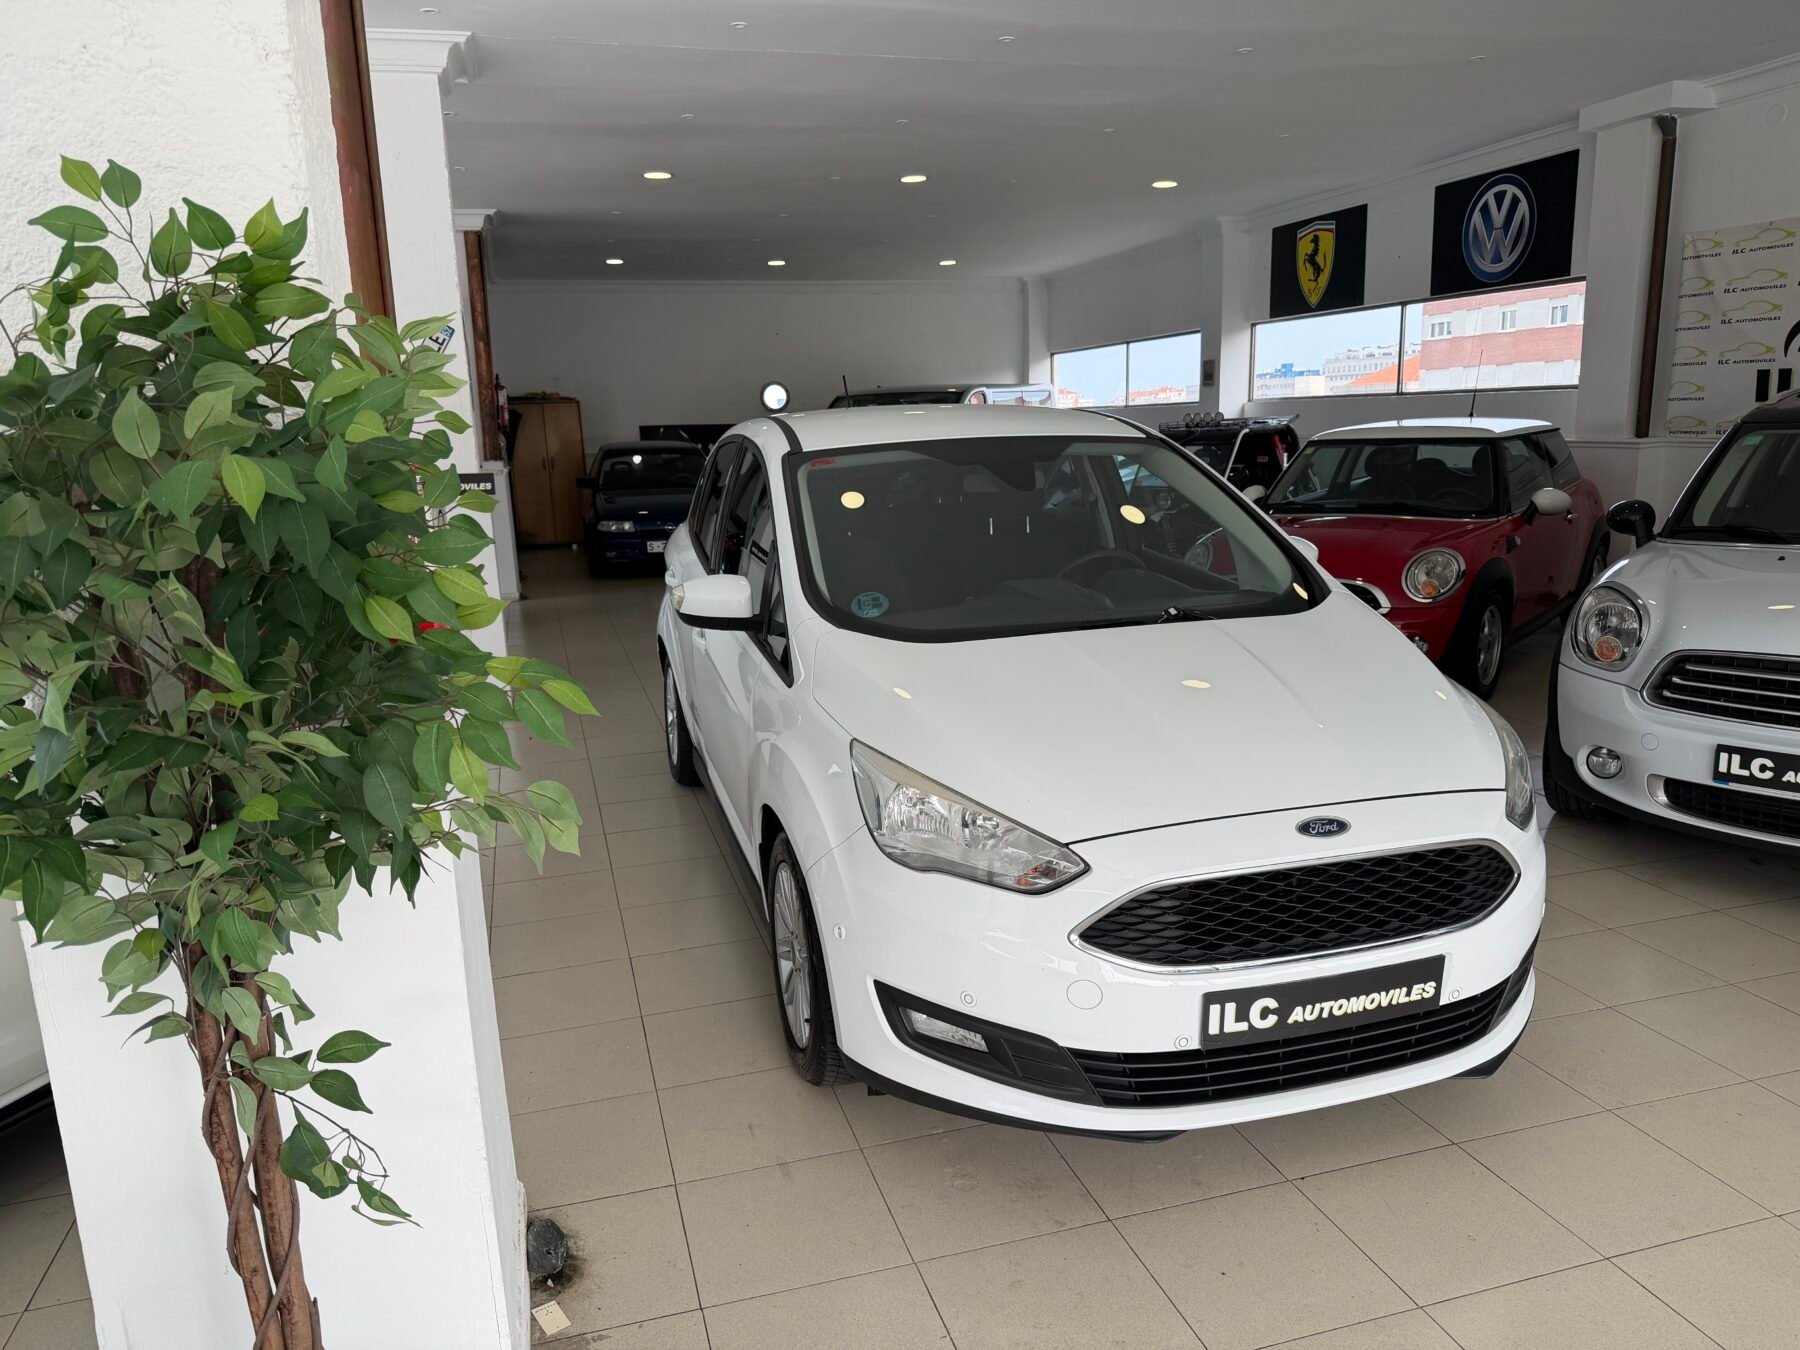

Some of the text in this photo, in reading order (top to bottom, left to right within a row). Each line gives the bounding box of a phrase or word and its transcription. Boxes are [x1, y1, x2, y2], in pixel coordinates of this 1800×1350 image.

[1732, 242, 1794, 255] ILC AUTOMOVILES
[1740, 283, 1787, 293] AUTOMOVILES
[1734, 315, 1781, 324] AUTOMOVILES
[1732, 357, 1776, 365] AUTOMOVILES
[1718, 751, 1776, 780] ILC
[1309, 819, 1339, 834] Ford
[1208, 981, 1437, 1035] ILC AUTOMOVILES
